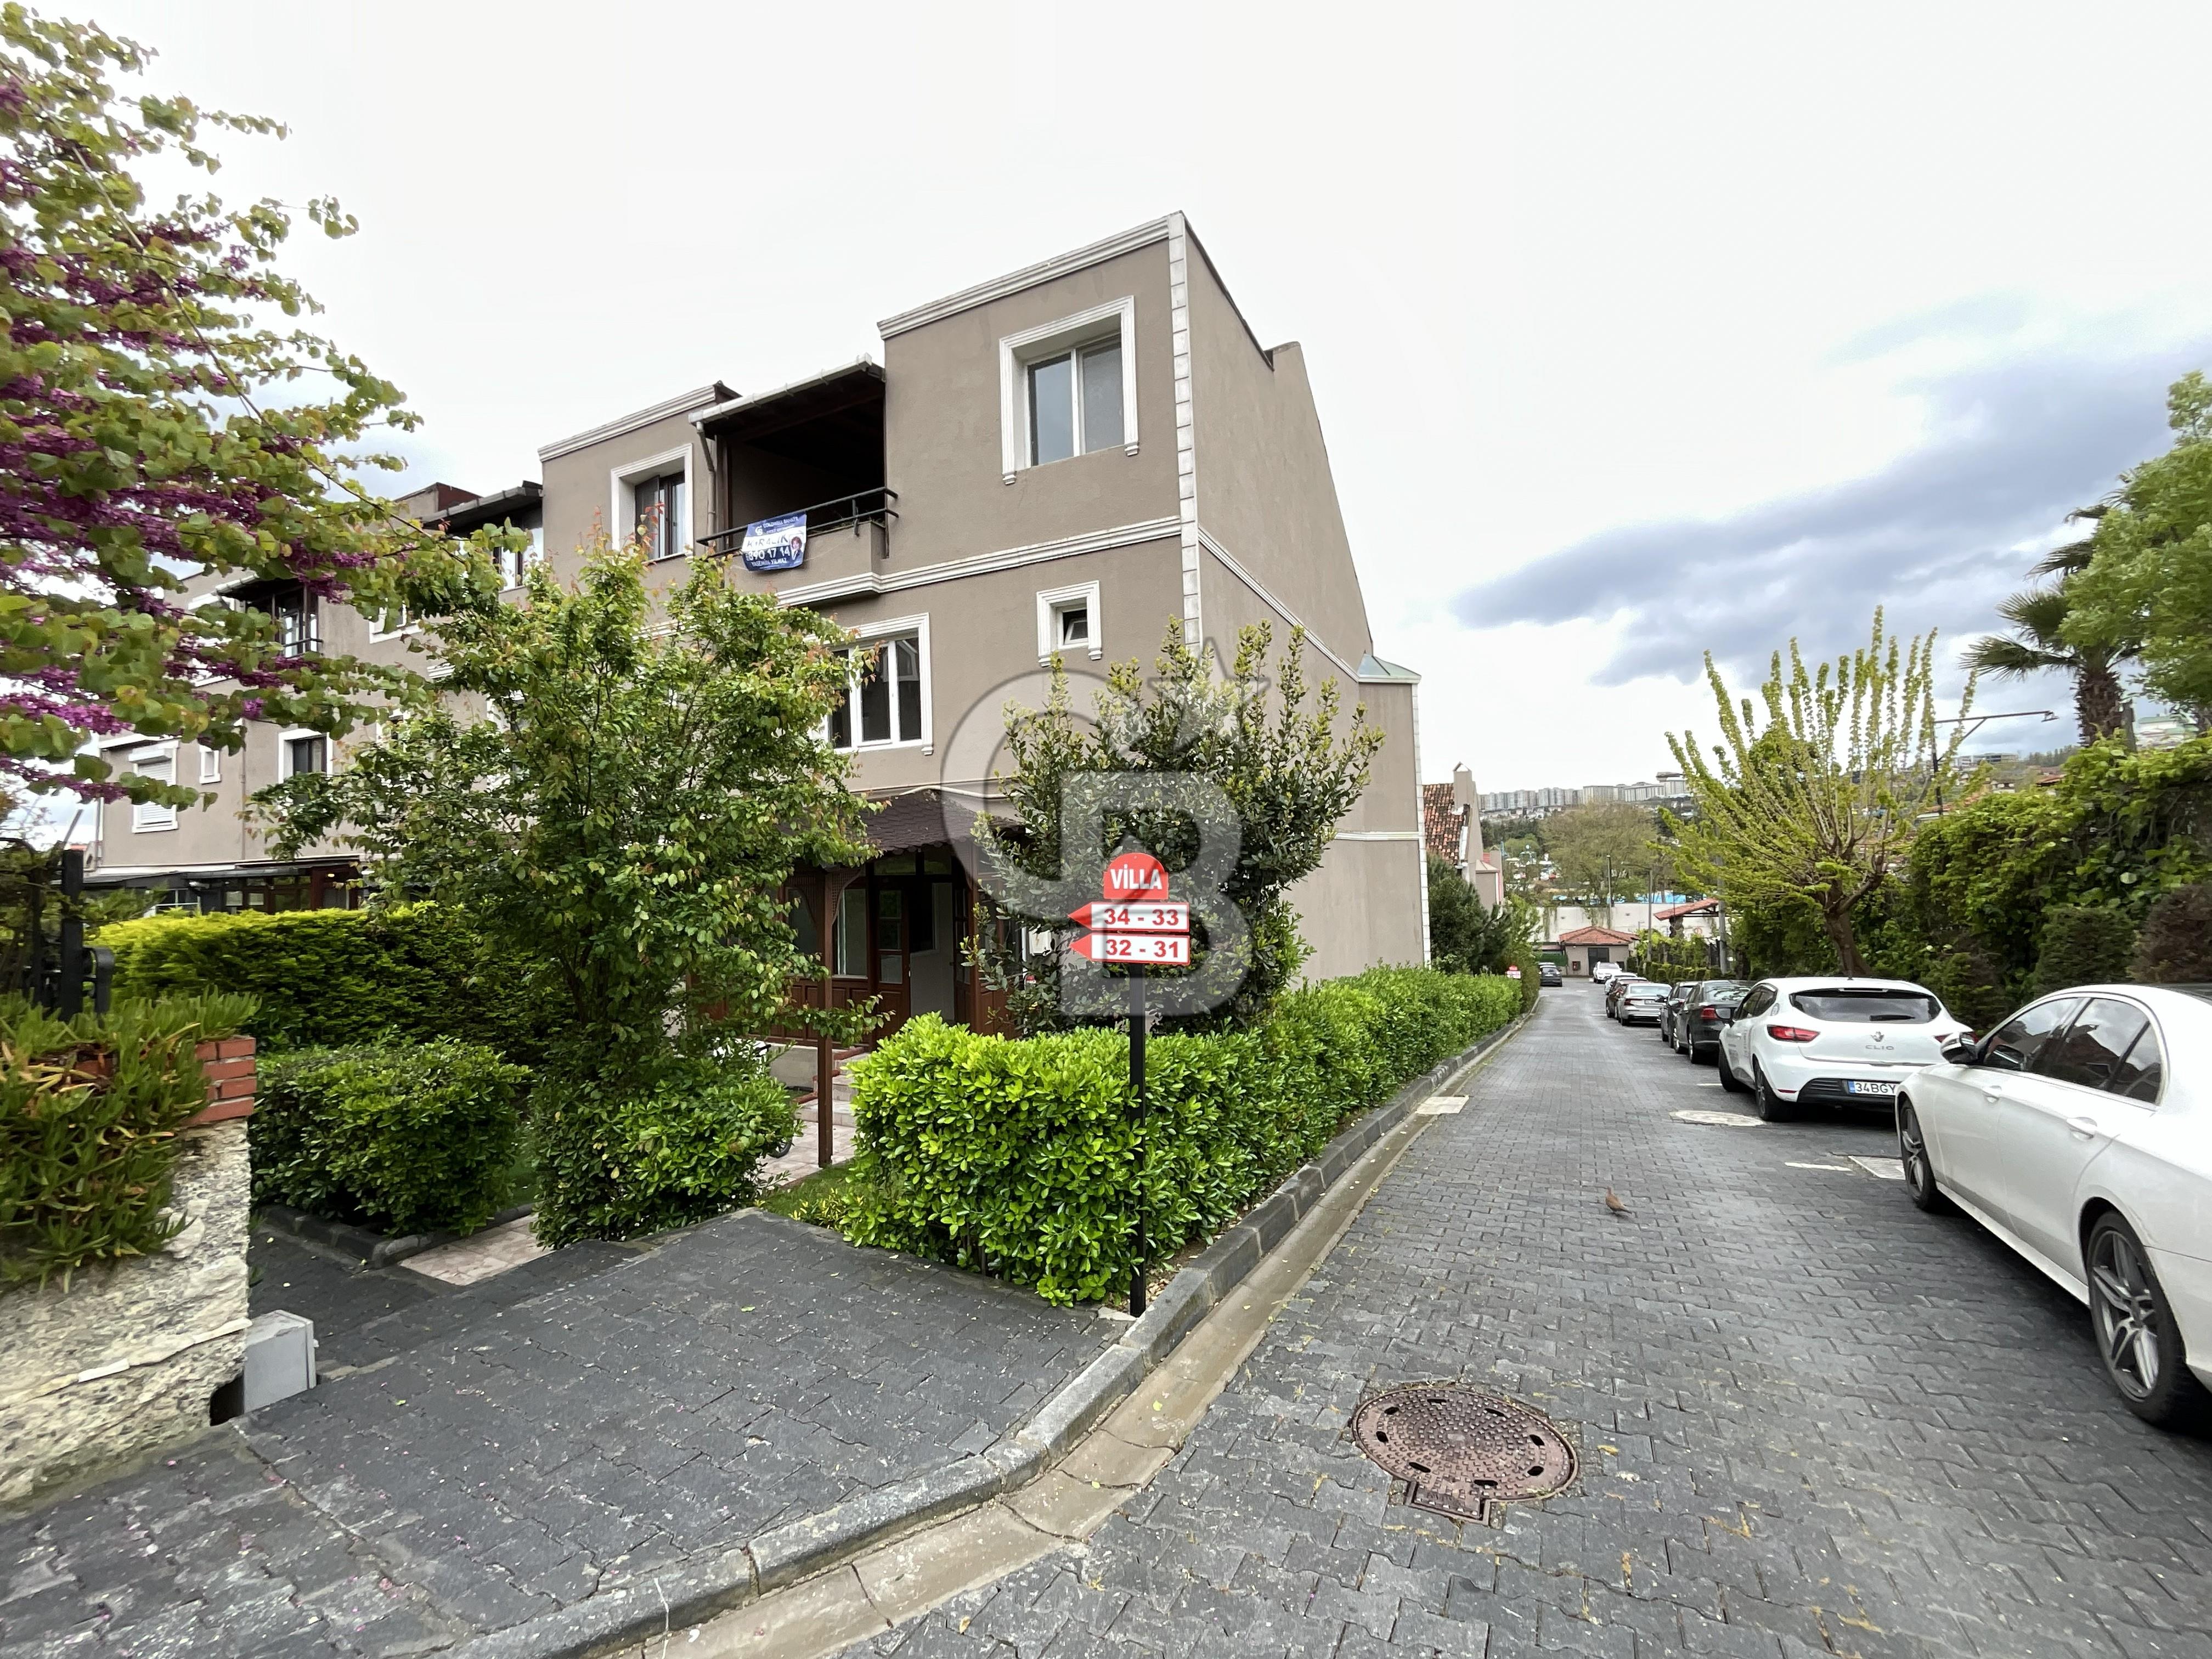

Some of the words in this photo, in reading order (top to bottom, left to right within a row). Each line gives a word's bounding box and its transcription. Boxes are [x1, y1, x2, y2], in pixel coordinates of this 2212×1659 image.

[767, 547, 777, 558] 17
[780, 546, 791, 557] 14
[1110, 864, 1163, 889] VİLLA
[1104, 909, 1130, 926] 34
[1152, 909, 1179, 926] 33
[1105, 939, 1132, 956] 32
[1154, 941, 1178, 958] 31
